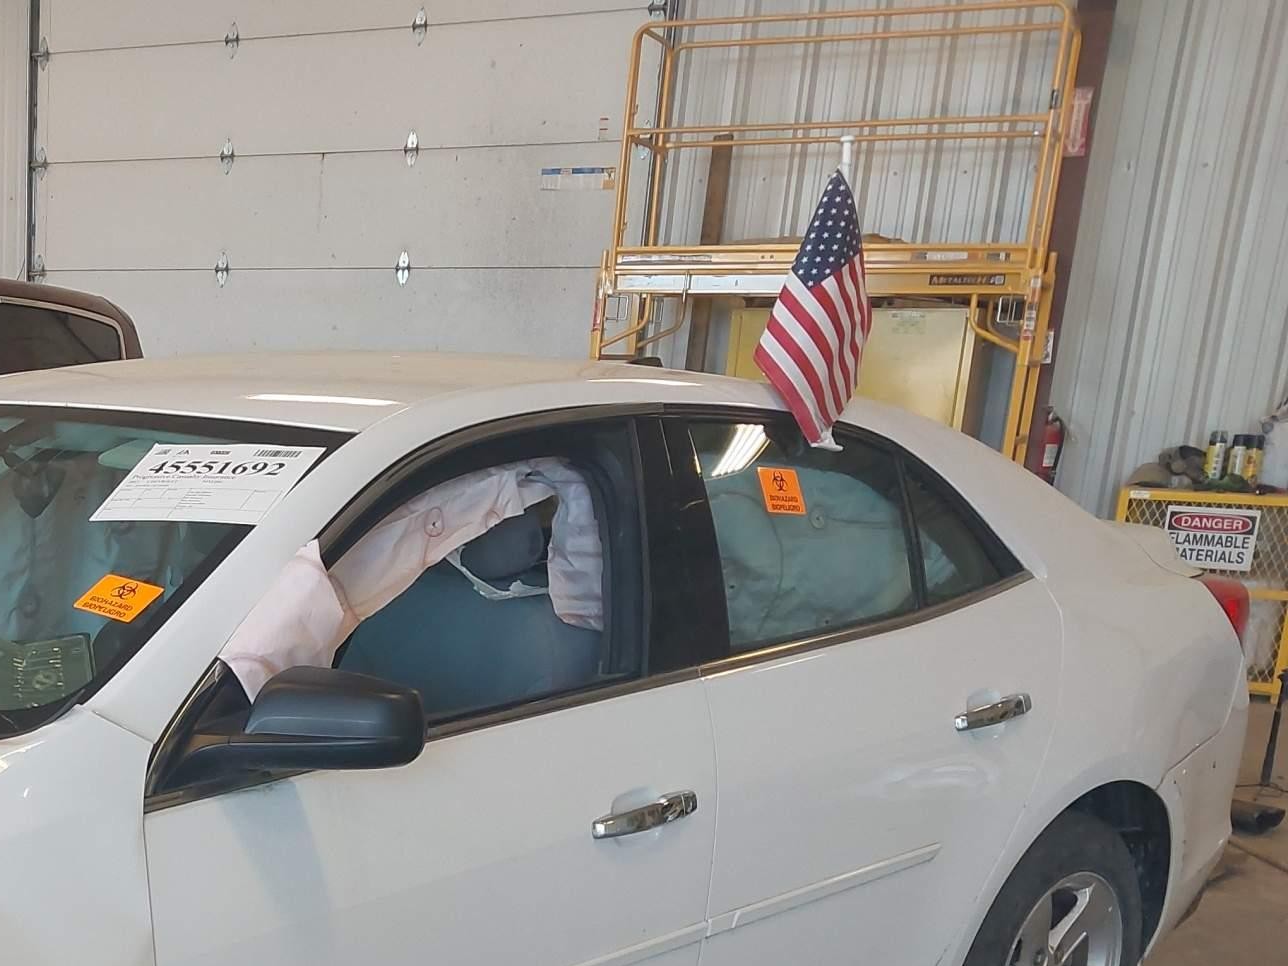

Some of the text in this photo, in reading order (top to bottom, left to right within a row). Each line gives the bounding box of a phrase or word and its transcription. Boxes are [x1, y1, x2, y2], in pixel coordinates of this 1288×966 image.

[148, 460, 287, 476] 45551692
[1181, 516, 1243, 530] DANGER
[1176, 547, 1245, 565] ATERIALS
[81, 601, 126, 618] BIOPELIGRO
[89, 595, 134, 611] BIOHAZARD
